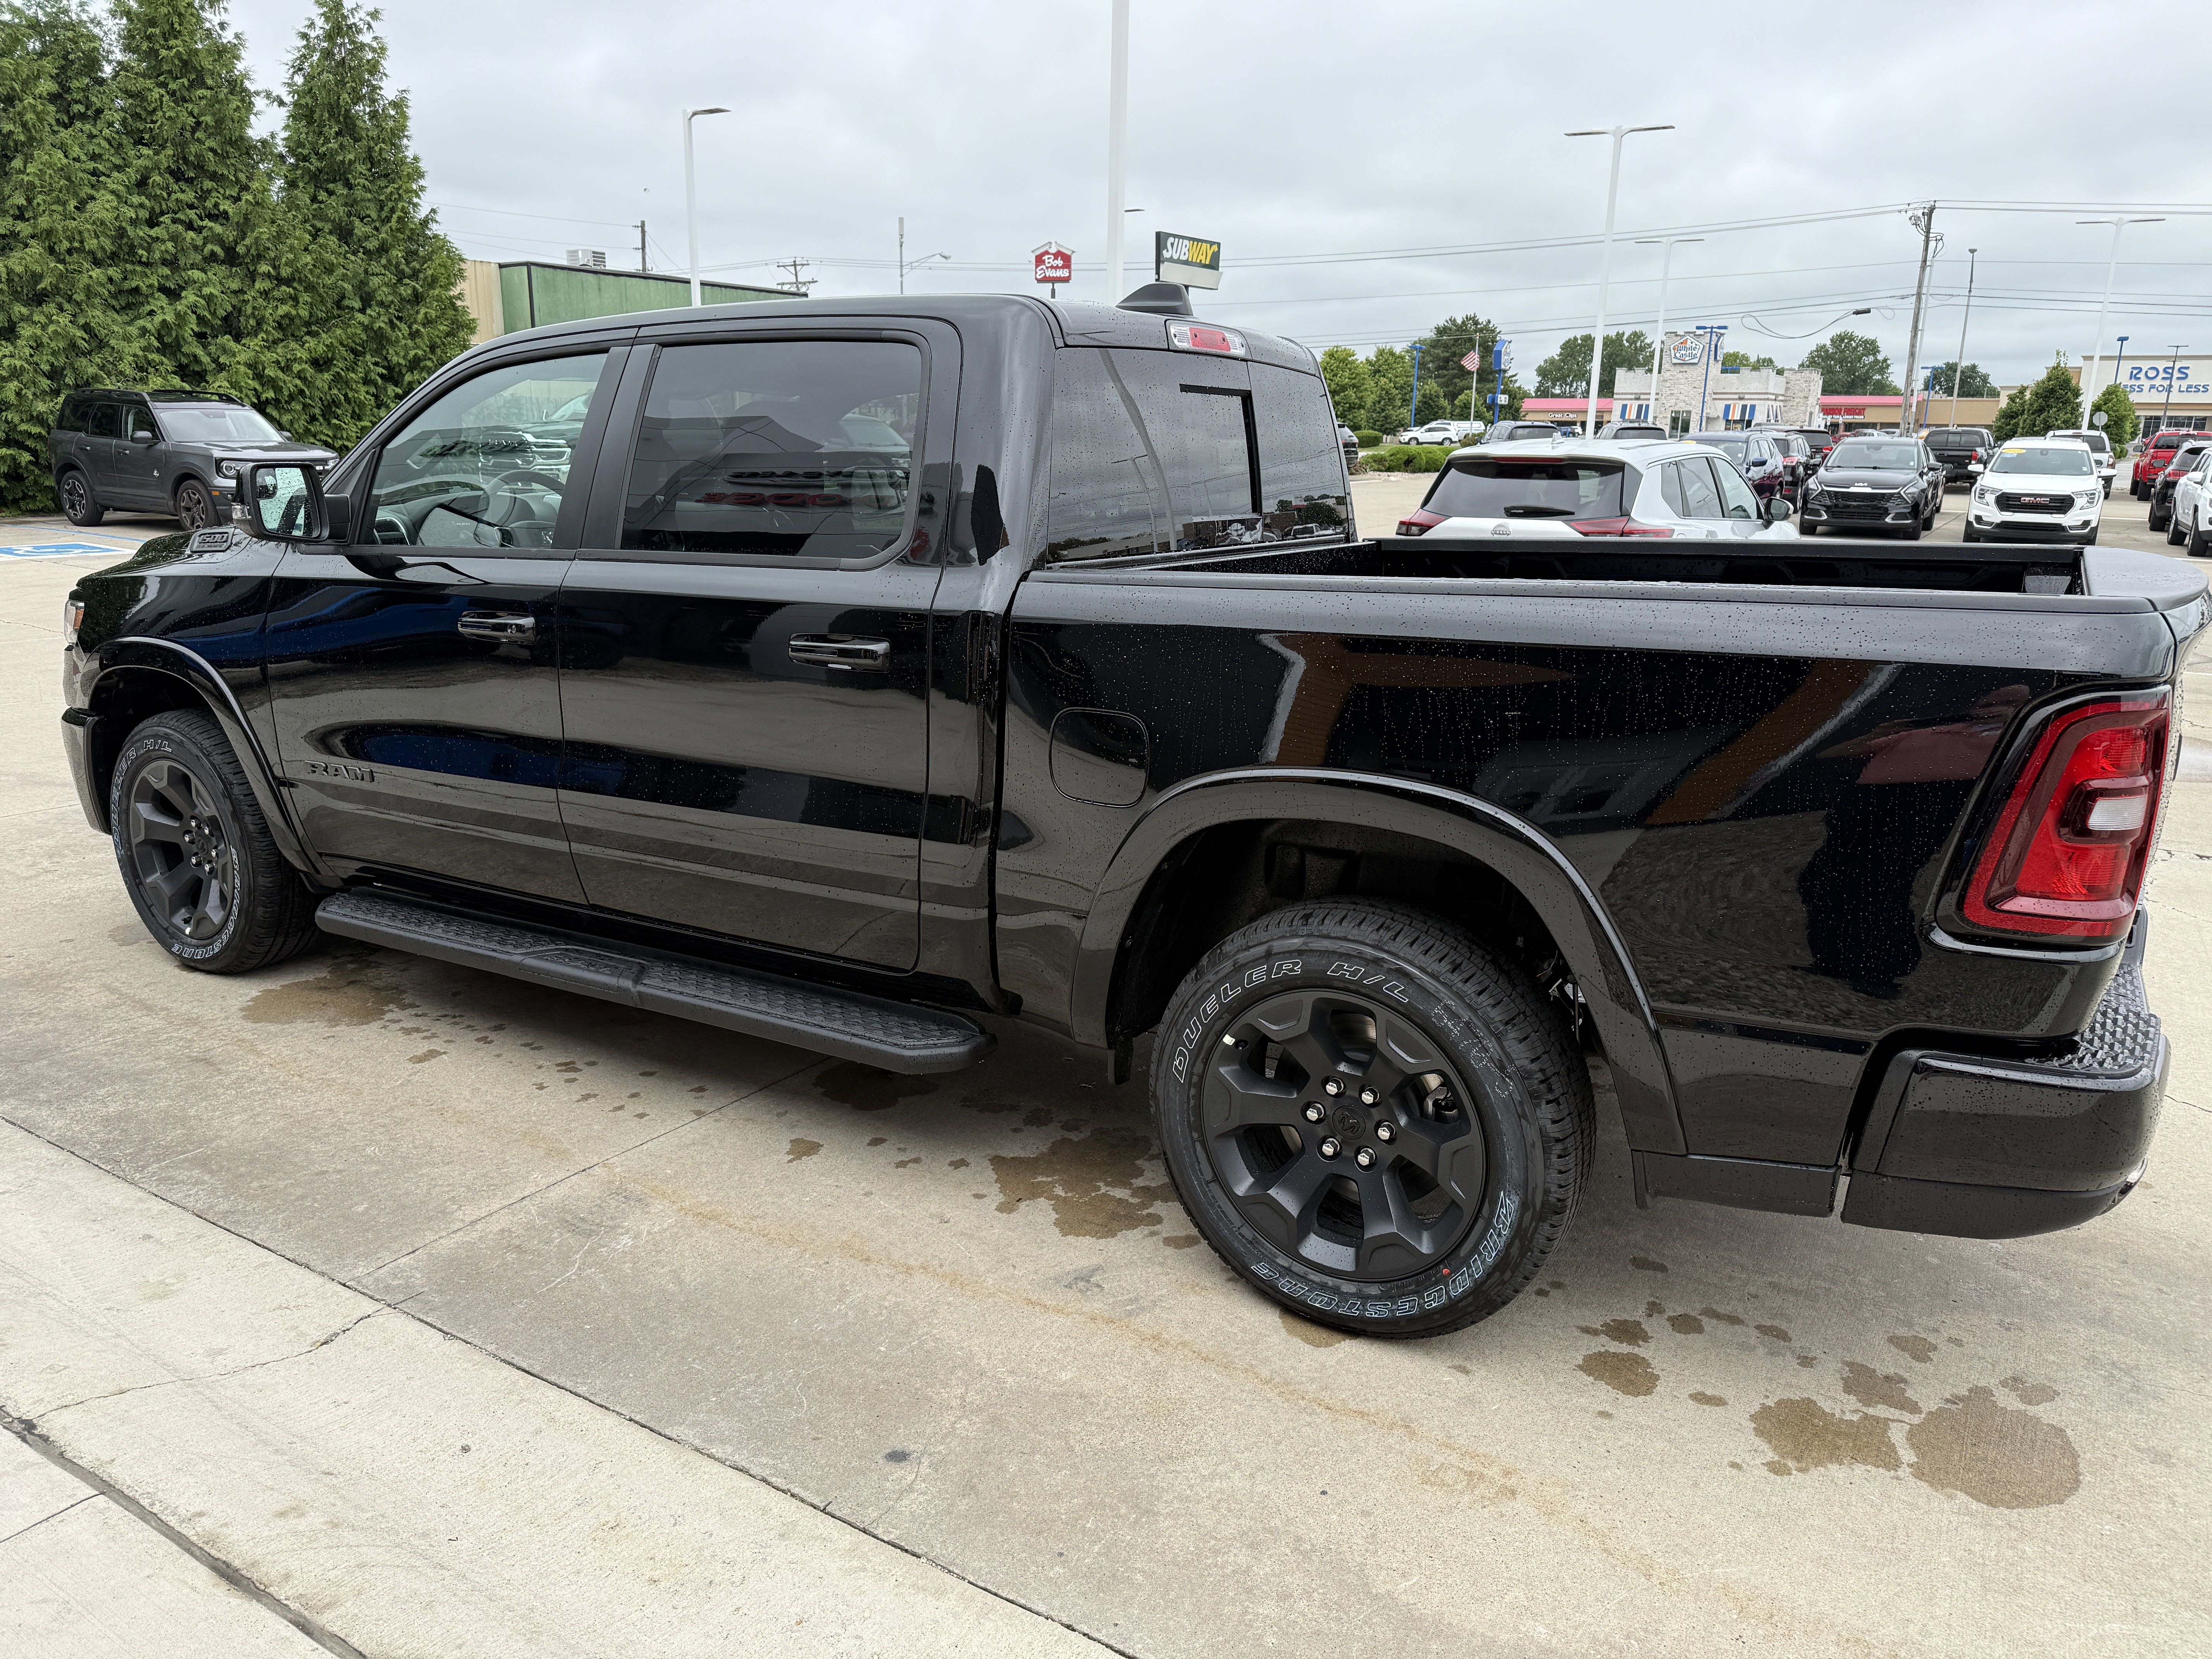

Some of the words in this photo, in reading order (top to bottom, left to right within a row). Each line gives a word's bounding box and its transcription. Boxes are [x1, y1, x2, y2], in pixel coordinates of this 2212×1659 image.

[1042, 255, 1063, 266] Bob
[1163, 237, 1218, 264] SUBWAY
[1036, 265, 1069, 278] Evans
[2130, 367, 2190, 380] ROSS
[2149, 384, 2173, 392] FOR
[2178, 384, 2209, 392] LESS
[198, 534, 228, 543] 1500
[305, 760, 374, 782] RAM
[112, 747, 136, 850] DUELER
[144, 739, 172, 752] H/L
[172, 845, 240, 958] BRIDGESTONE
[1173, 959, 1302, 1083] DUELER
[1327, 962, 1408, 1002] H/L
[1250, 1191, 1514, 1317] BRIDGESTONE
